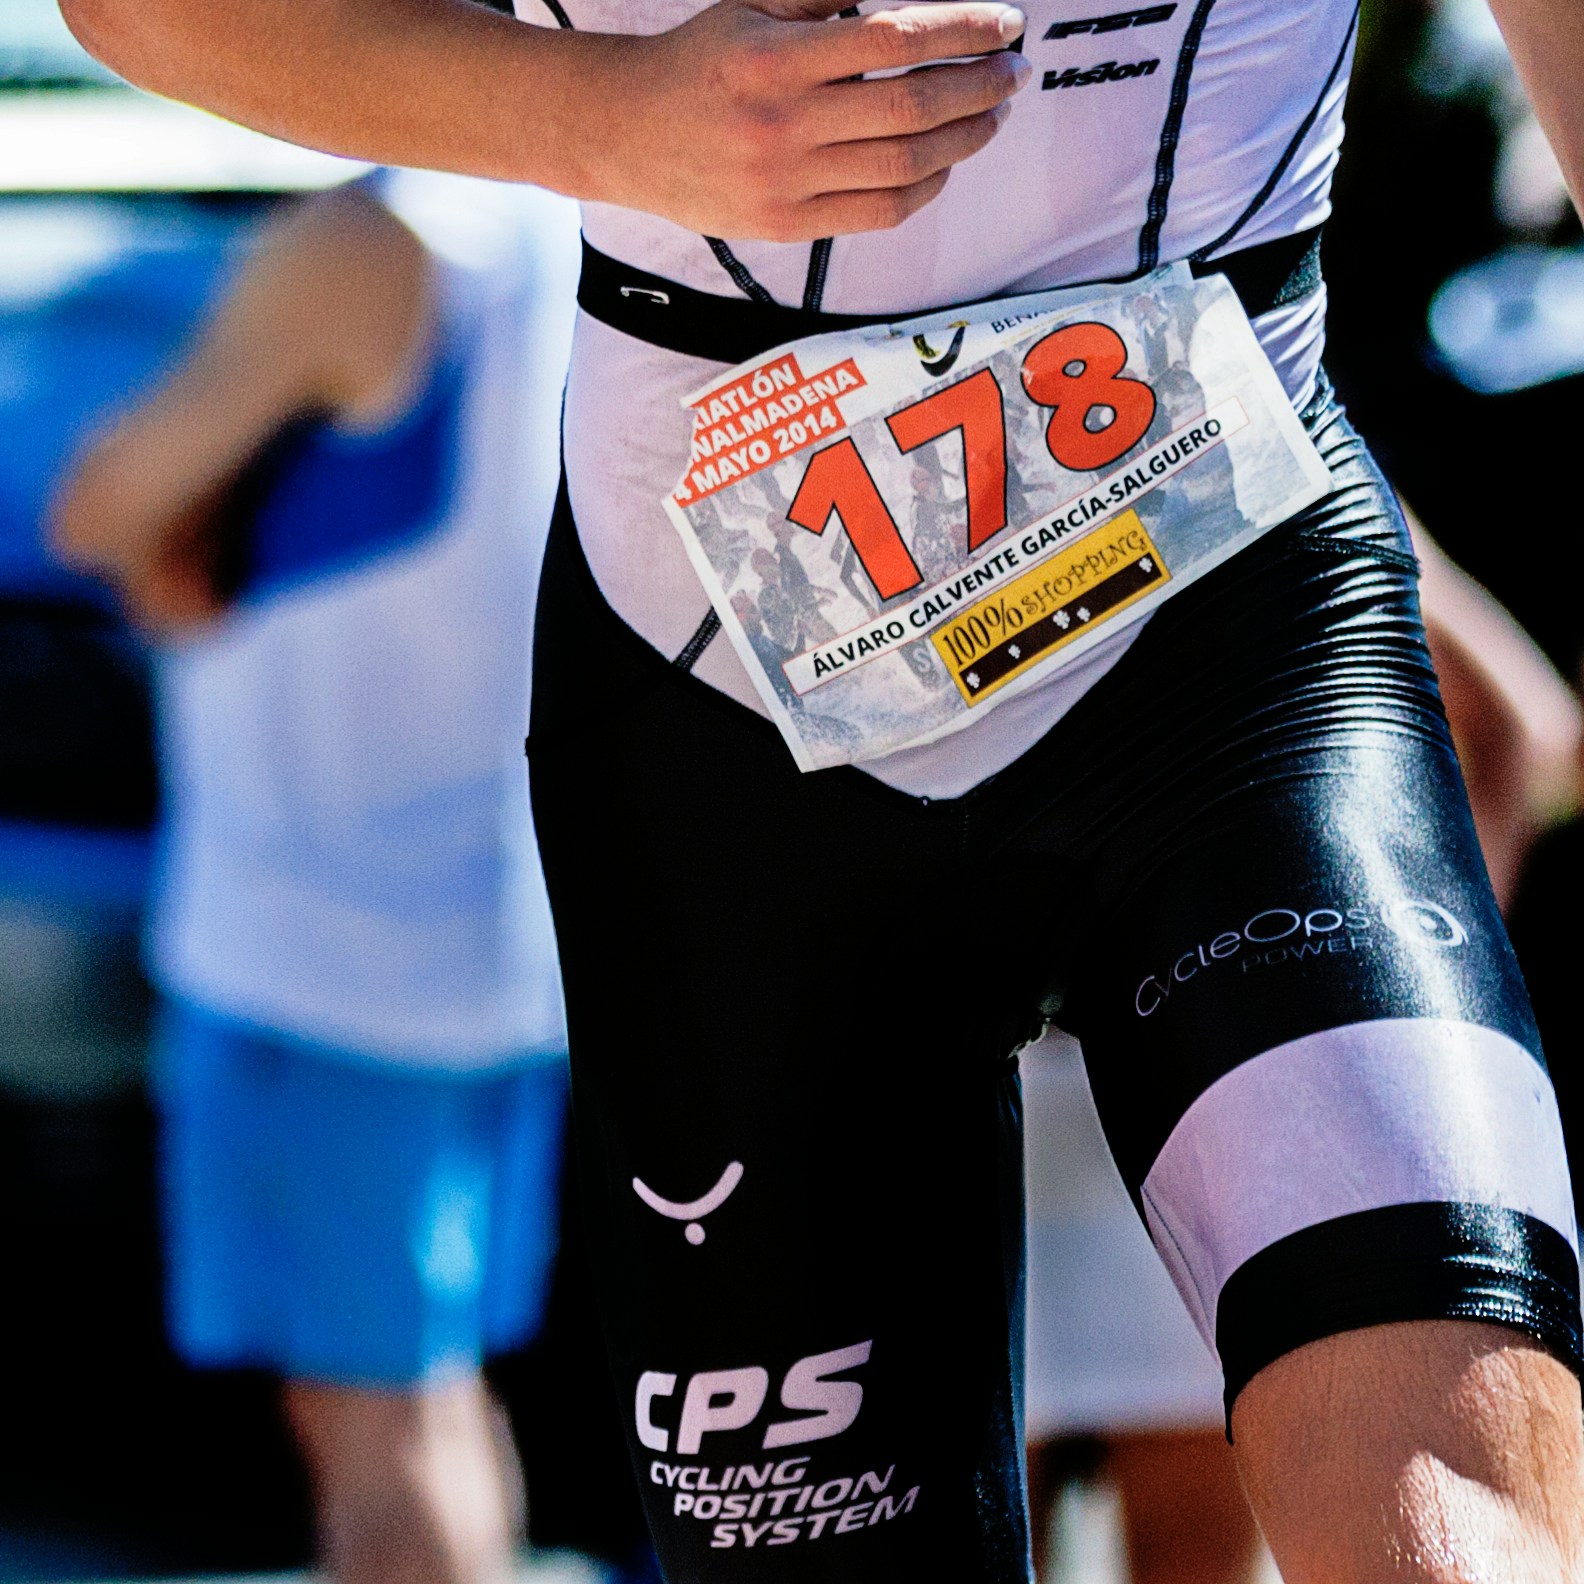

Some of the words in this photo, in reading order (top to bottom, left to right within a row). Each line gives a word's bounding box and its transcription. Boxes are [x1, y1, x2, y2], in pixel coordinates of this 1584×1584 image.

[1041, 58, 1161, 91] Vision
[691, 440, 772, 494] MAYO
[773, 405, 837, 454] 2014
[785, 320, 1158, 604] 178
[813, 621, 905, 678] ÁLVARO
[909, 548, 1019, 628] CALVENTE
[1021, 418, 1222, 555] GARCÍA-SALGUERO
[942, 597, 1025, 667] 100%
[1022, 530, 1148, 616] SHOPPING
[1135, 908, 1372, 1017] CycleOps
[1242, 934, 1374, 973] POWER
[634, 1339, 873, 1455] CPS
[649, 1456, 811, 1491] CYCLING
[674, 1464, 896, 1520] POSITION
[710, 1485, 921, 1548] SYSTEM
